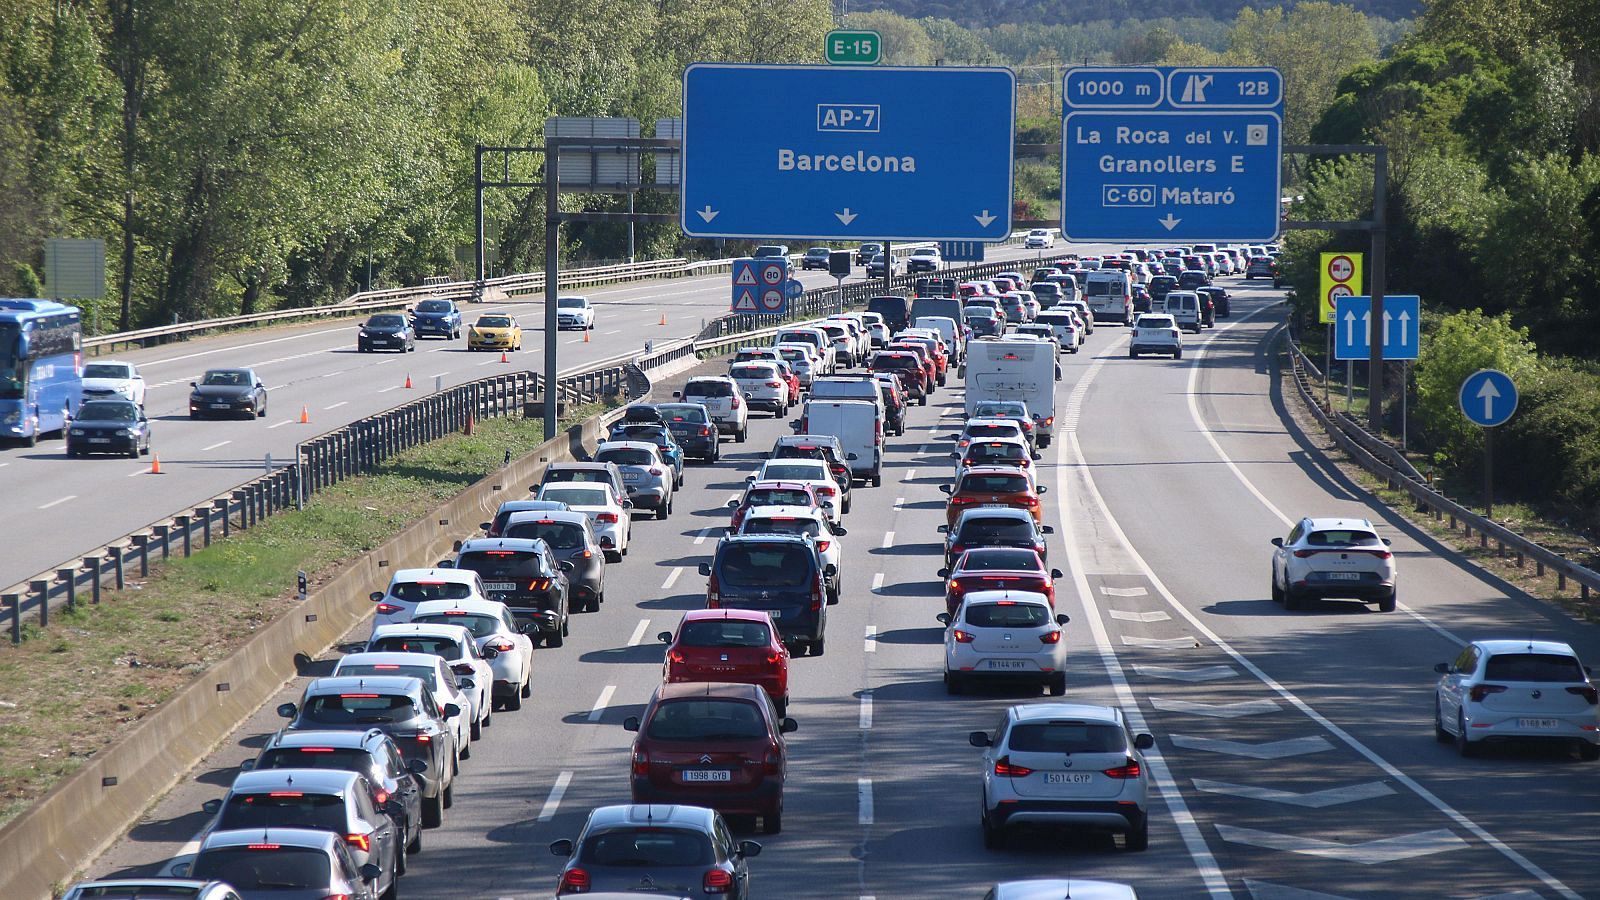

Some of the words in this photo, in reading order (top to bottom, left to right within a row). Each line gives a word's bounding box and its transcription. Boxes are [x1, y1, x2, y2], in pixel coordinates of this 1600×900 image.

[834, 39, 872, 55] E-15
[1077, 80, 1124, 96] 1000
[1135, 84, 1151, 96] m
[1237, 81, 1269, 96] 12B
[822, 109, 875, 127] AP-7
[1076, 126, 1101, 144] La
[1116, 126, 1170, 144] Roca
[1185, 130, 1212, 144] del
[1223, 130, 1239, 144] V.
[778, 149, 916, 172] Barcelona
[1099, 154, 1217, 173] Granollers
[1231, 155, 1245, 173] E
[1107, 188, 1152, 203] C-60
[1161, 186, 1235, 205] Mataró
[766, 271, 779, 279] 80
[690, 771, 709, 780] 1998
[712, 771, 727, 780] GYB
[1048, 774, 1072, 783] 5014
[1074, 774, 1091, 783] GYP
